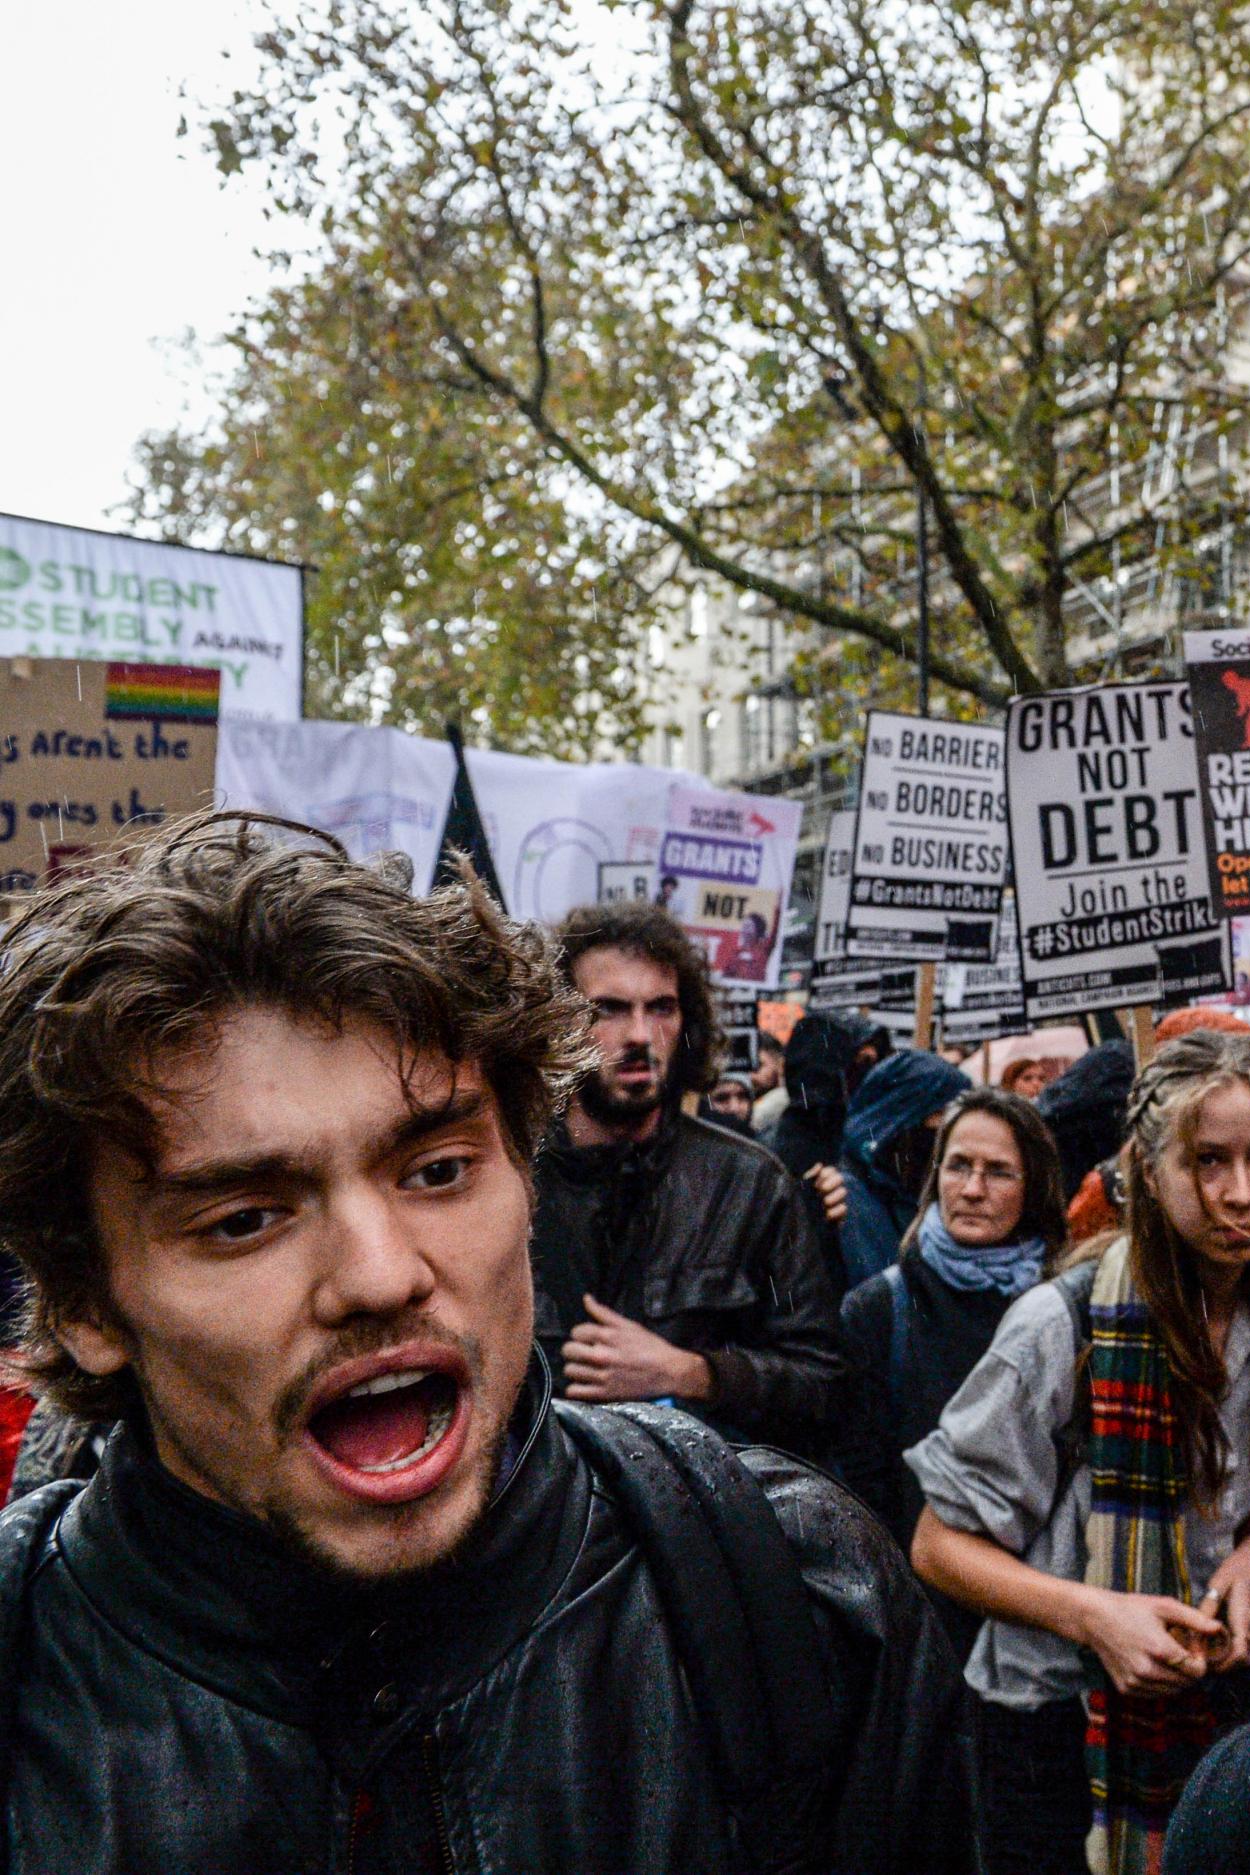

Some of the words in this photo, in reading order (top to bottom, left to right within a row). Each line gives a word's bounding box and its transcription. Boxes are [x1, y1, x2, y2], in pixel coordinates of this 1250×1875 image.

[40, 559, 219, 612] STUDENT
[135, 721, 189, 759] the
[872, 737, 893, 758] NO
[900, 729, 1002, 771] BARRIER
[1077, 747, 1151, 794] NOT
[867, 790, 889, 811] NO
[895, 781, 1007, 823] BORDERS
[1038, 789, 1196, 869] DEBT
[664, 840, 760, 879] GRANTS
[861, 843, 884, 865] NO
[892, 836, 1003, 875] BUSINESS
[703, 891, 748, 919] NOT
[1060, 877, 1128, 918] Join
[1141, 869, 1187, 902] the
[1221, 874, 1249, 895] let
